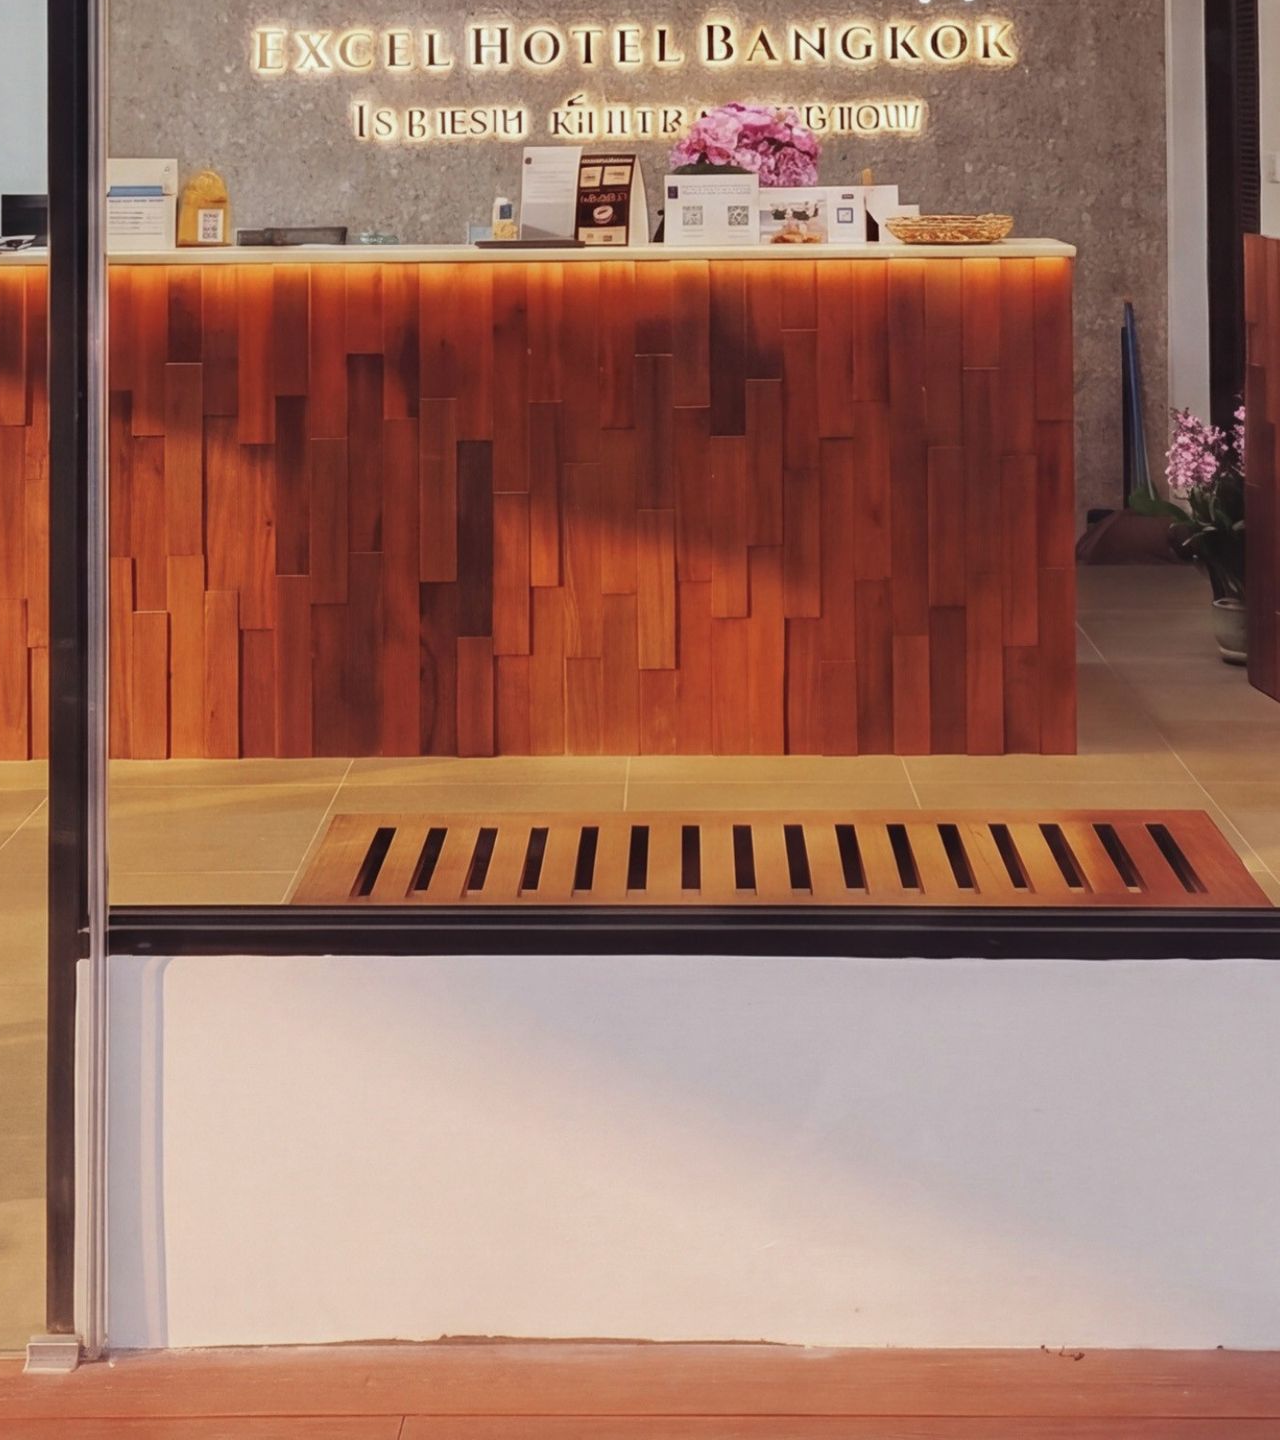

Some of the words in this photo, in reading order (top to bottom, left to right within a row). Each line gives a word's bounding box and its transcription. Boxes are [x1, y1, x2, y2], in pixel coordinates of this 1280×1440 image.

[255, 29, 453, 70] EXCEL
[471, 26, 683, 66] HOTEL
[705, 24, 1014, 62] BANGKOK
